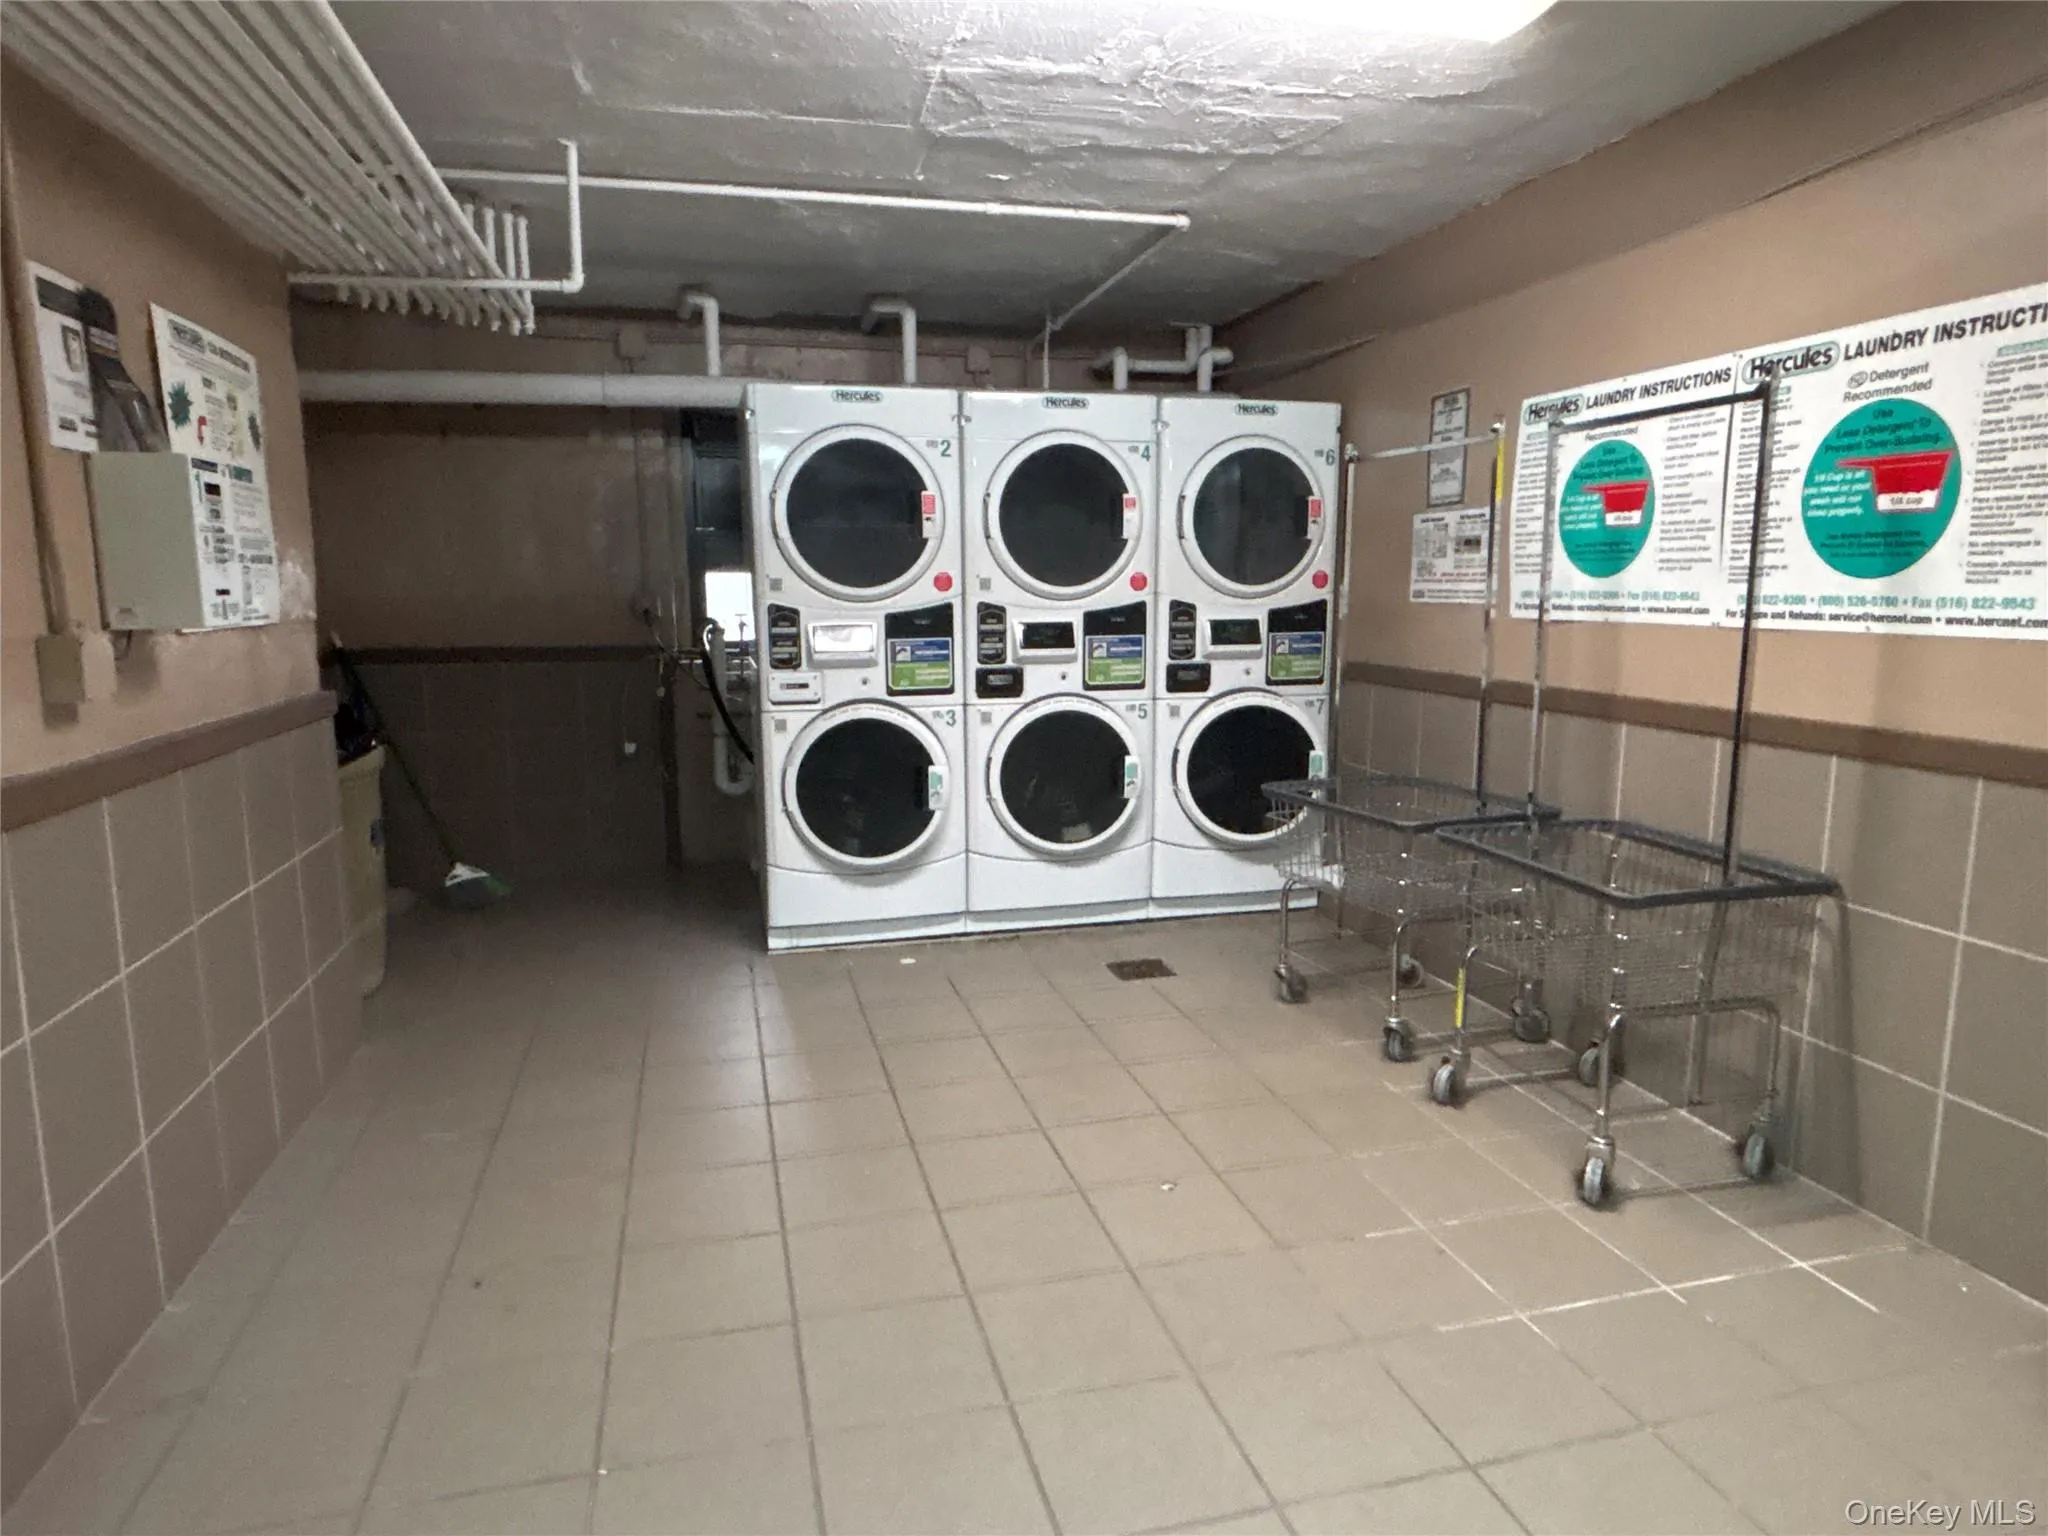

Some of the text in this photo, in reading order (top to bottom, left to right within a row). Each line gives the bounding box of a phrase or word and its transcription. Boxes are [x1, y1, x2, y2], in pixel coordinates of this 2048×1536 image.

[1749, 345, 1834, 380] Hercules
[1844, 327, 1928, 361] LAUNDRY
[1869, 361, 1930, 382] Detergent
[835, 390, 881, 402] Hercules
[1528, 366, 1732, 421] Hercules LAUNDRY INSTRUCTIONS
[1843, 378, 1934, 402] Recommended
[1045, 397, 1087, 408] Hercules
[1237, 403, 1277, 415] Hercules
[940, 439, 952, 458] 2
[1140, 445, 1152, 461] 4
[1325, 448, 1336, 466] 6
[1911, 595, 1932, 609] Fax
[1138, 702, 1148, 719] 5
[1315, 697, 1326, 715] 7
[945, 709, 956, 727] 3
